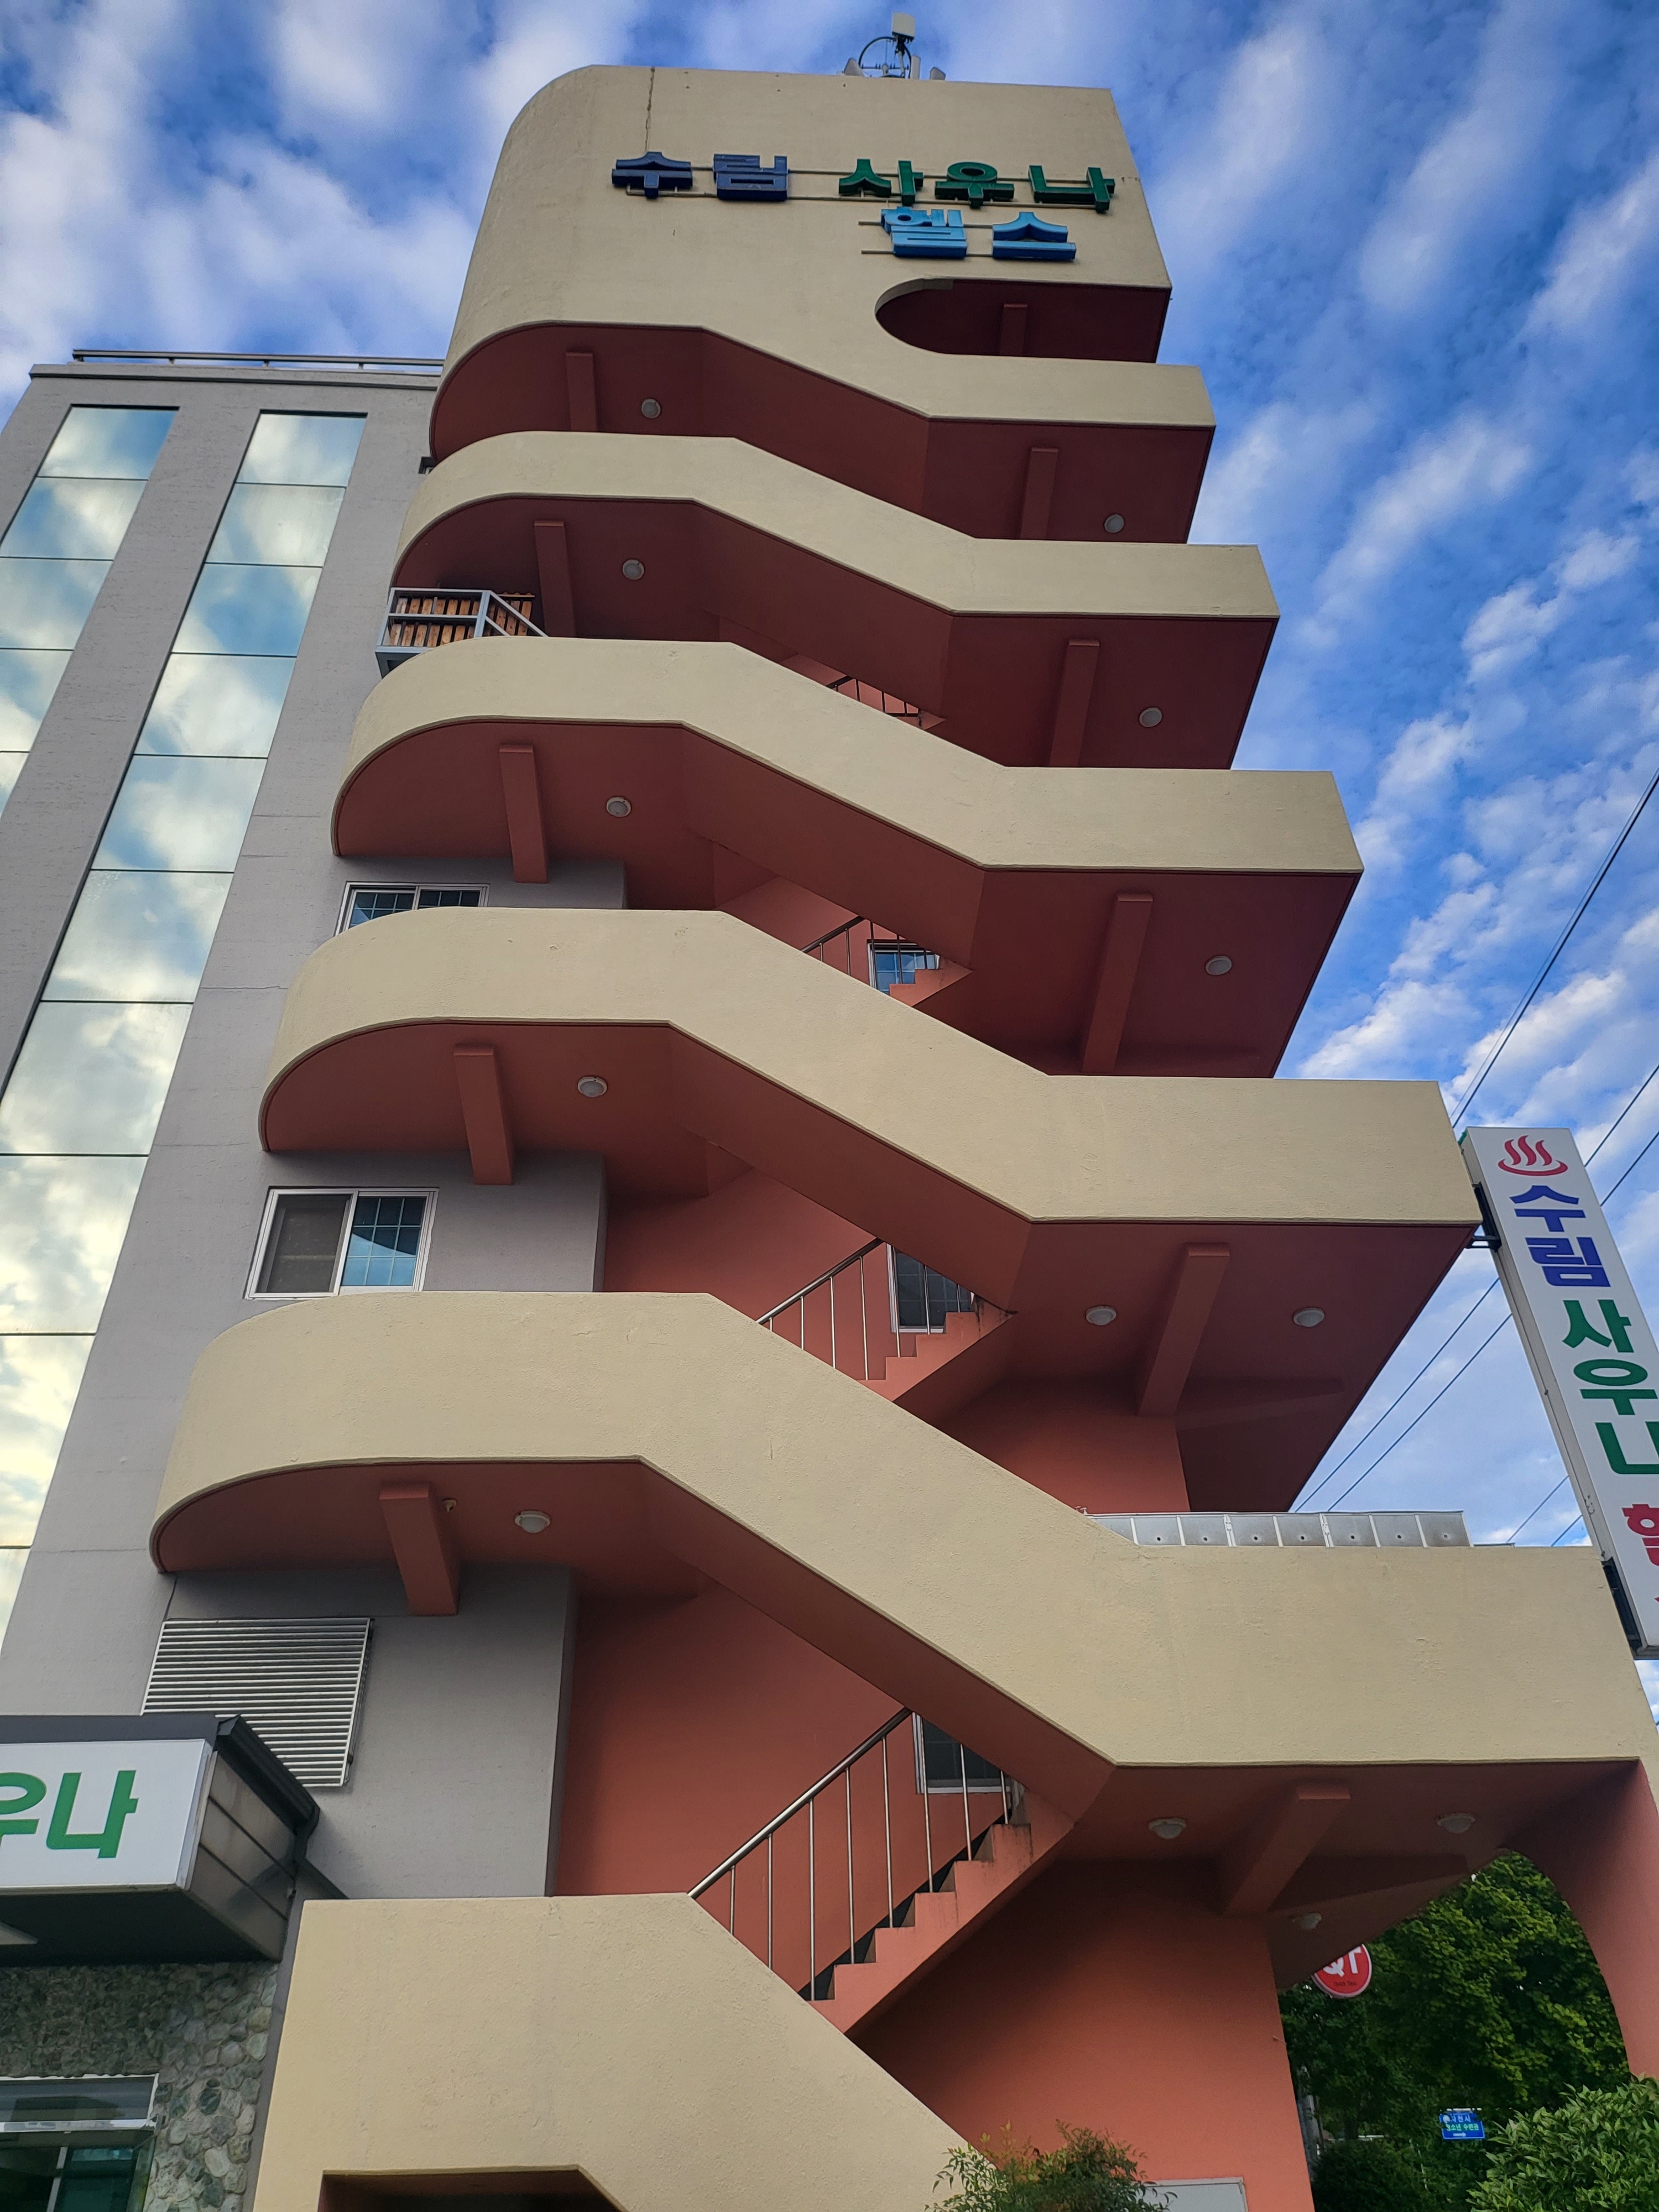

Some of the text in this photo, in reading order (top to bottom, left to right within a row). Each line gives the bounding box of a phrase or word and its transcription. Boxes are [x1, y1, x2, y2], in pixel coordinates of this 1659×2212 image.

[611, 152, 1115, 213] 수림 사우나
[881, 206, 1076, 260] 헬스
[1509, 1185, 1659, 1475] 수림 사우나
